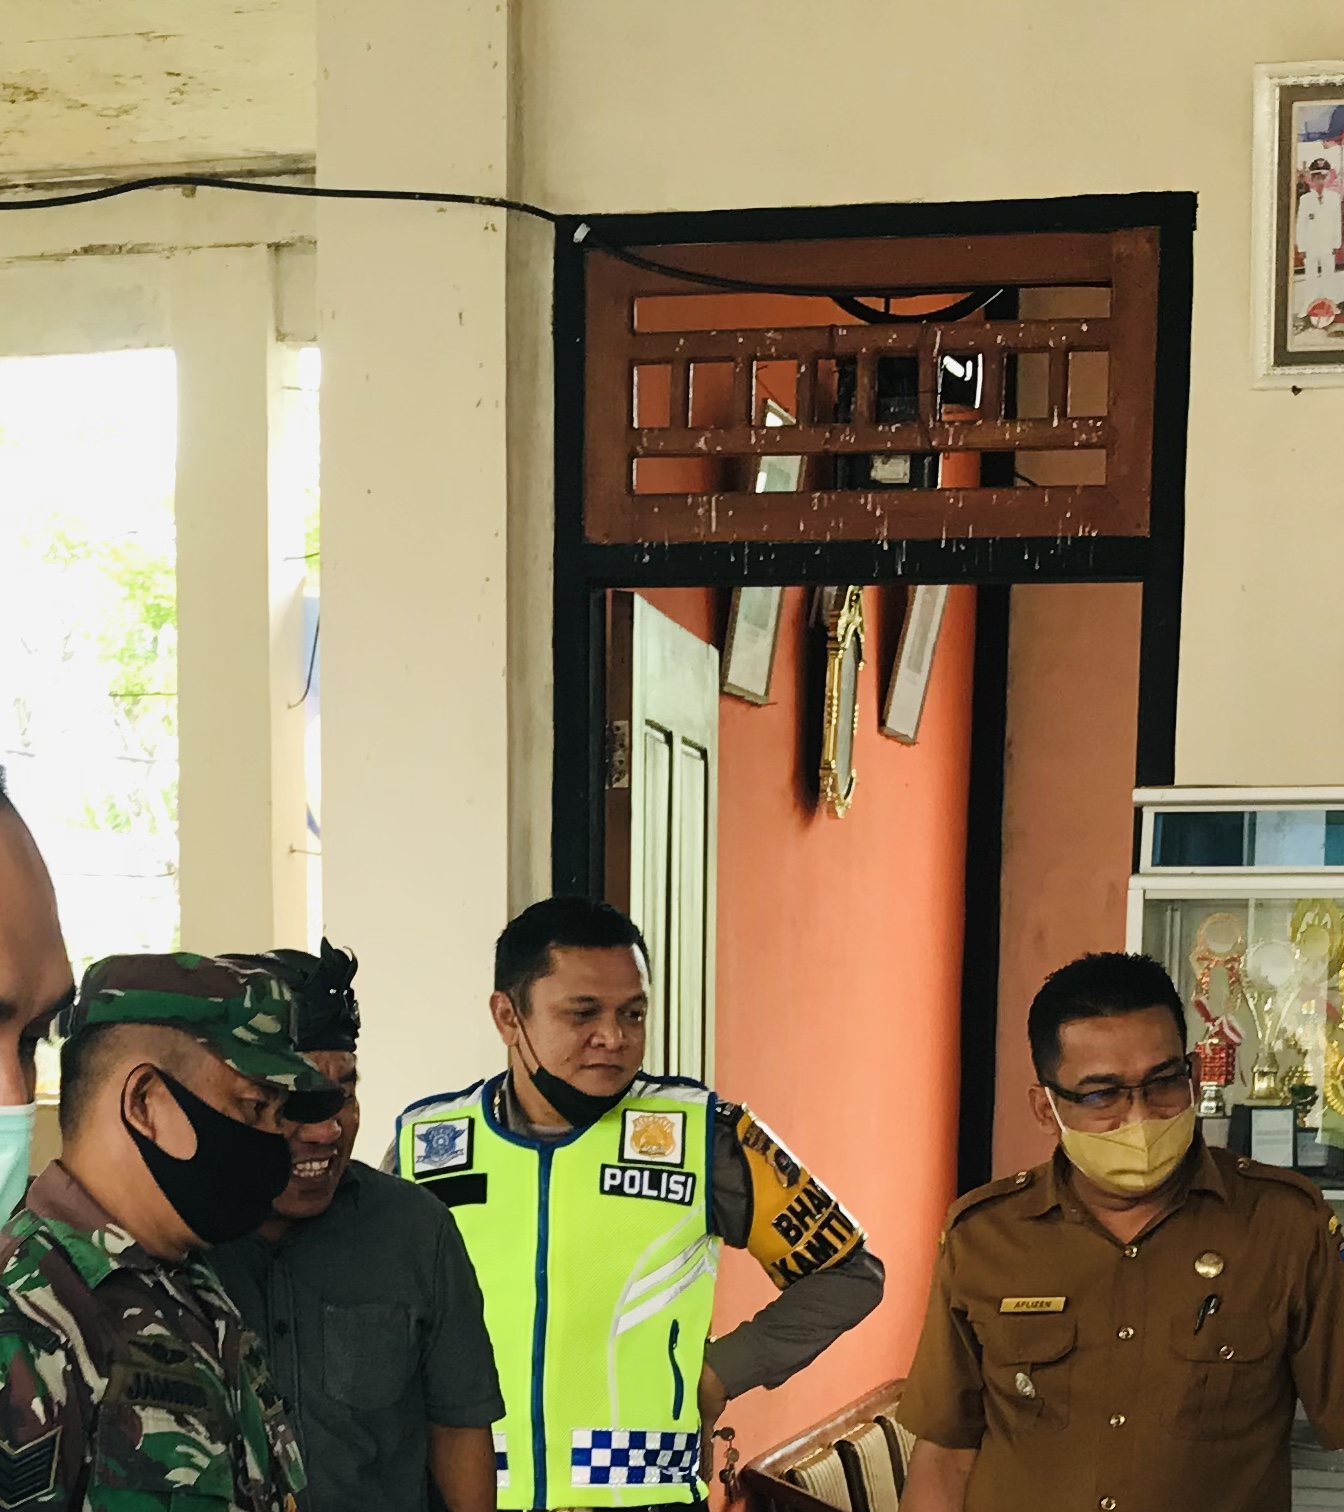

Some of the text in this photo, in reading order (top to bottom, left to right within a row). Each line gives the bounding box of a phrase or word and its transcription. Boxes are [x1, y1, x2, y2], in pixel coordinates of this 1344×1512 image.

[603, 1167, 693, 1203] POLISI
[771, 1177, 834, 1247] BHA
[771, 1202, 856, 1285] KAMTI
